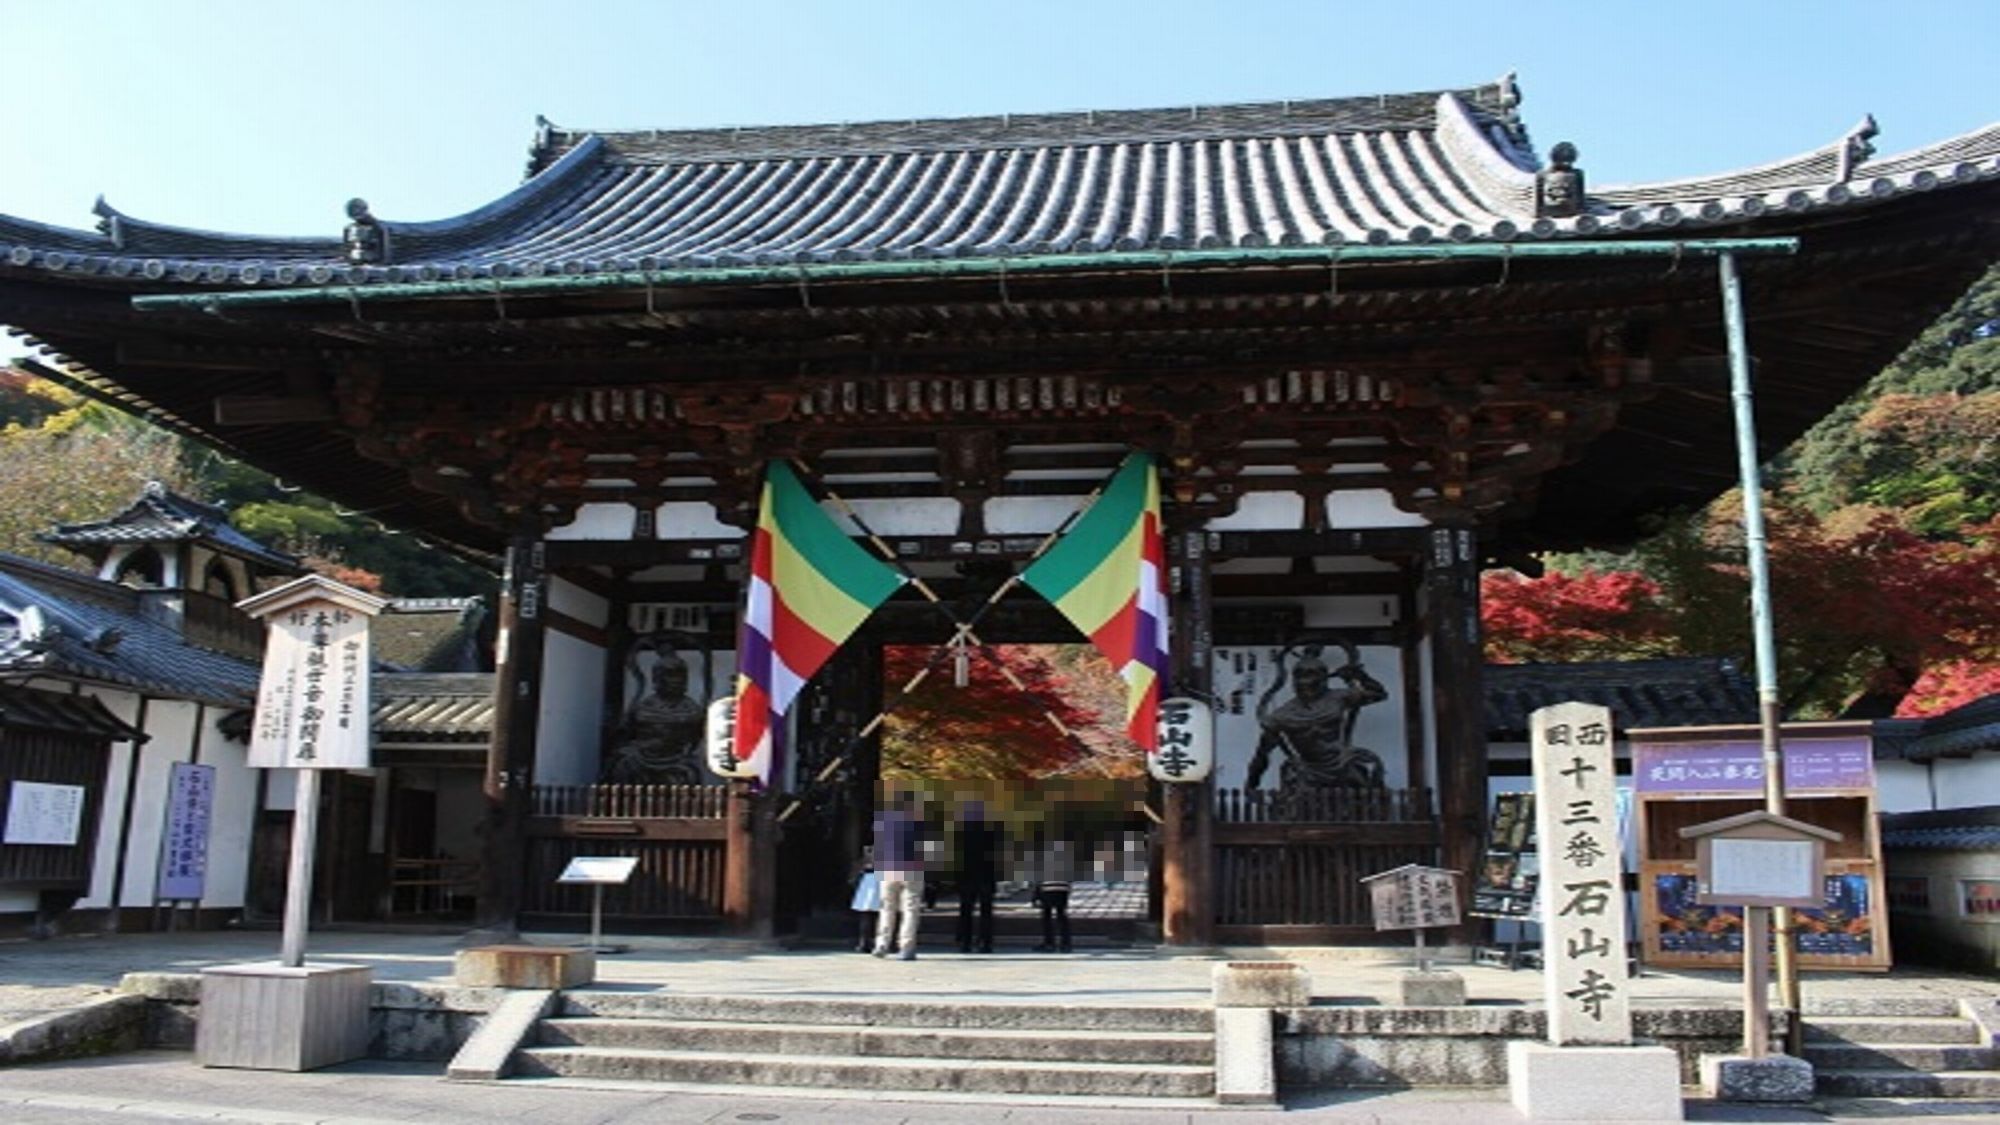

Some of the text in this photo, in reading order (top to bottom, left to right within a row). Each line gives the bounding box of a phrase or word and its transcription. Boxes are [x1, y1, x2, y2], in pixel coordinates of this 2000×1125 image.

[1157, 702, 1198, 778] 石山寺
[1649, 763, 1766, 783] 夜間入山券売
